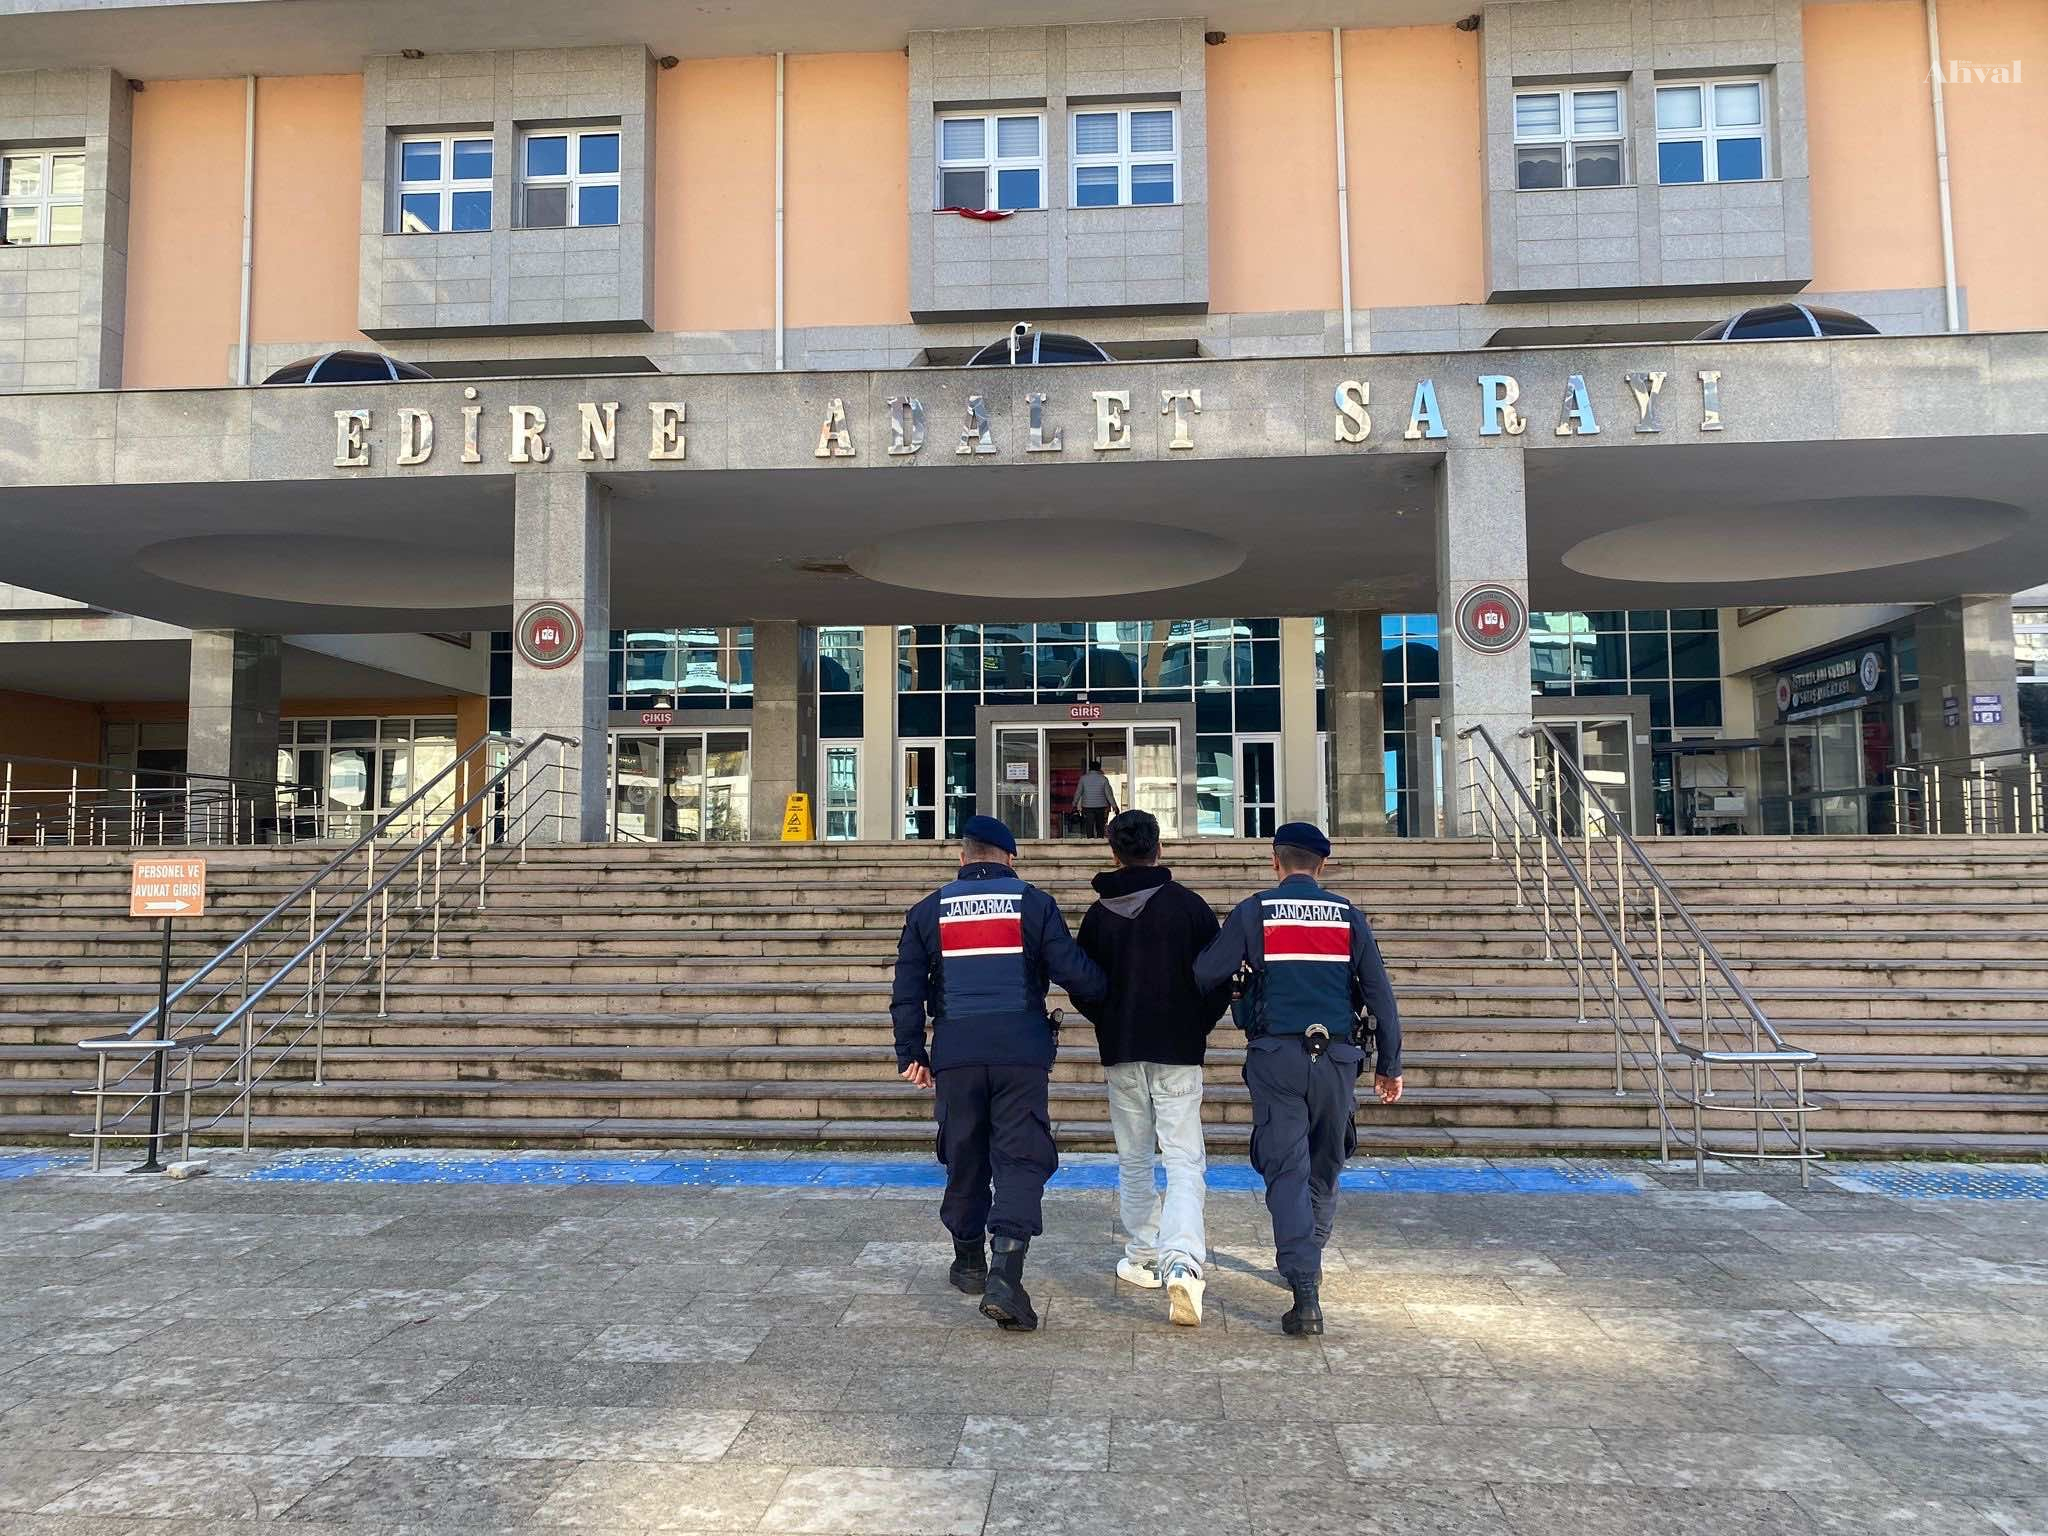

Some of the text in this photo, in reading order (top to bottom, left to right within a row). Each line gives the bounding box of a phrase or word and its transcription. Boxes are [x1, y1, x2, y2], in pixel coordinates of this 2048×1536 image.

[334, 369, 1724, 466] EDİRNE ADALET SARAYI
[642, 713, 672, 724] ÇIKIŞ
[138, 865, 199, 878] PERSONEL VE
[135, 884, 170, 897] AVUKAT
[946, 898, 1015, 917] JANDARMA
[1271, 903, 1343, 921] JANDARMA
